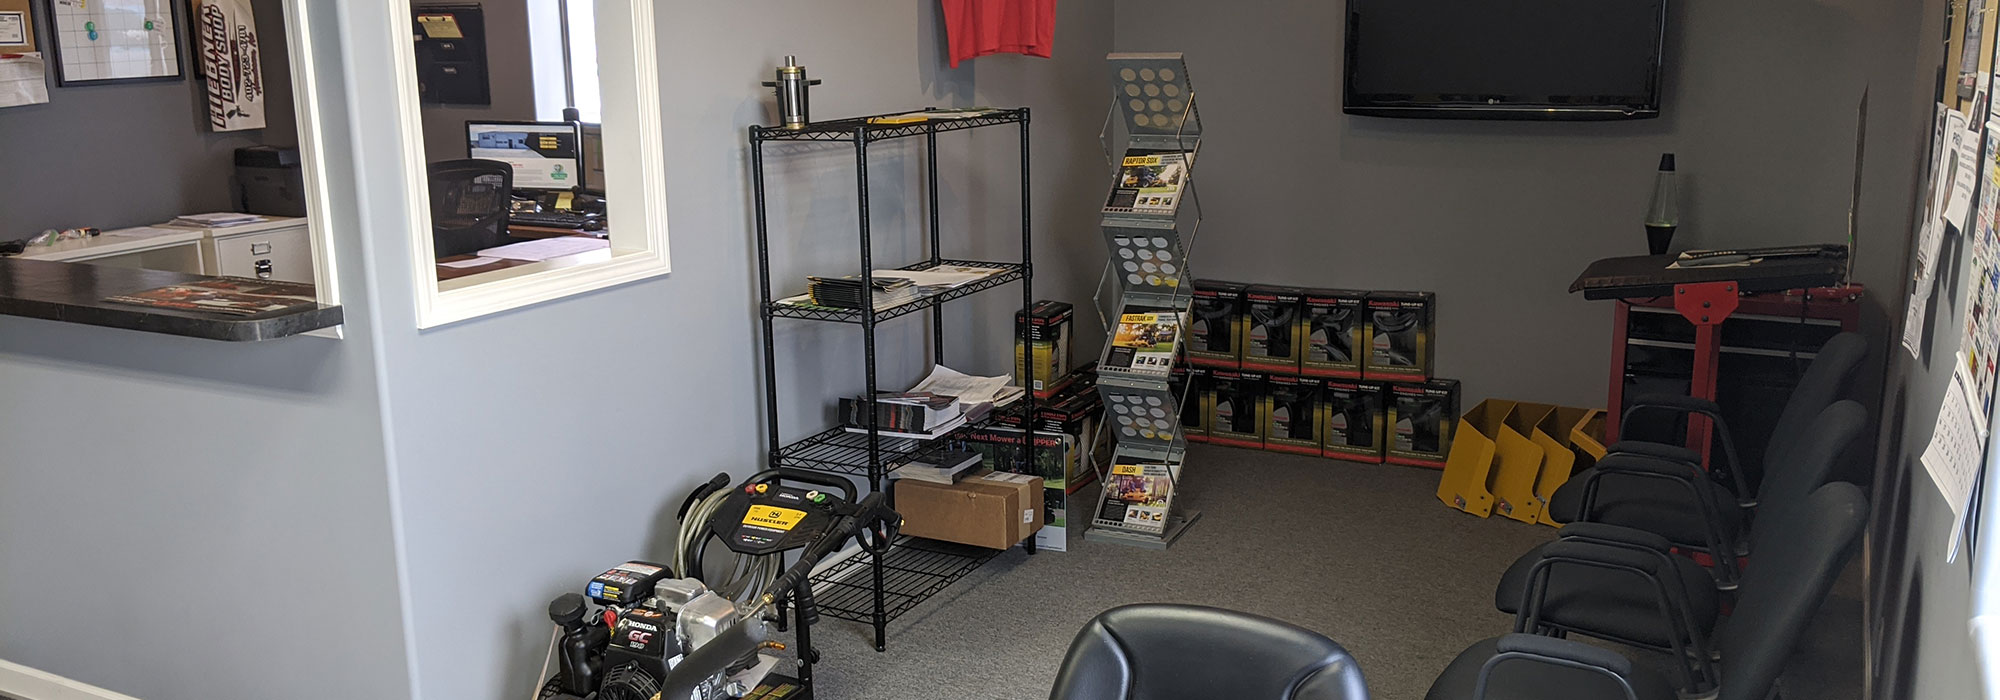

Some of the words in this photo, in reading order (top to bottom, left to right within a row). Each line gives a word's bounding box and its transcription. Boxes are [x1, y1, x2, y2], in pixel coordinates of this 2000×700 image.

[211, 4, 228, 54] SHOP
[217, 53, 235, 103] BODY
[1125, 157, 1147, 165] RAPTOR
[970, 433, 989, 441] Next
[990, 434, 1015, 444] Mower
[751, 517, 788, 525] HUSTLER
[628, 620, 657, 631] HONDA
[628, 630, 652, 643] GC
